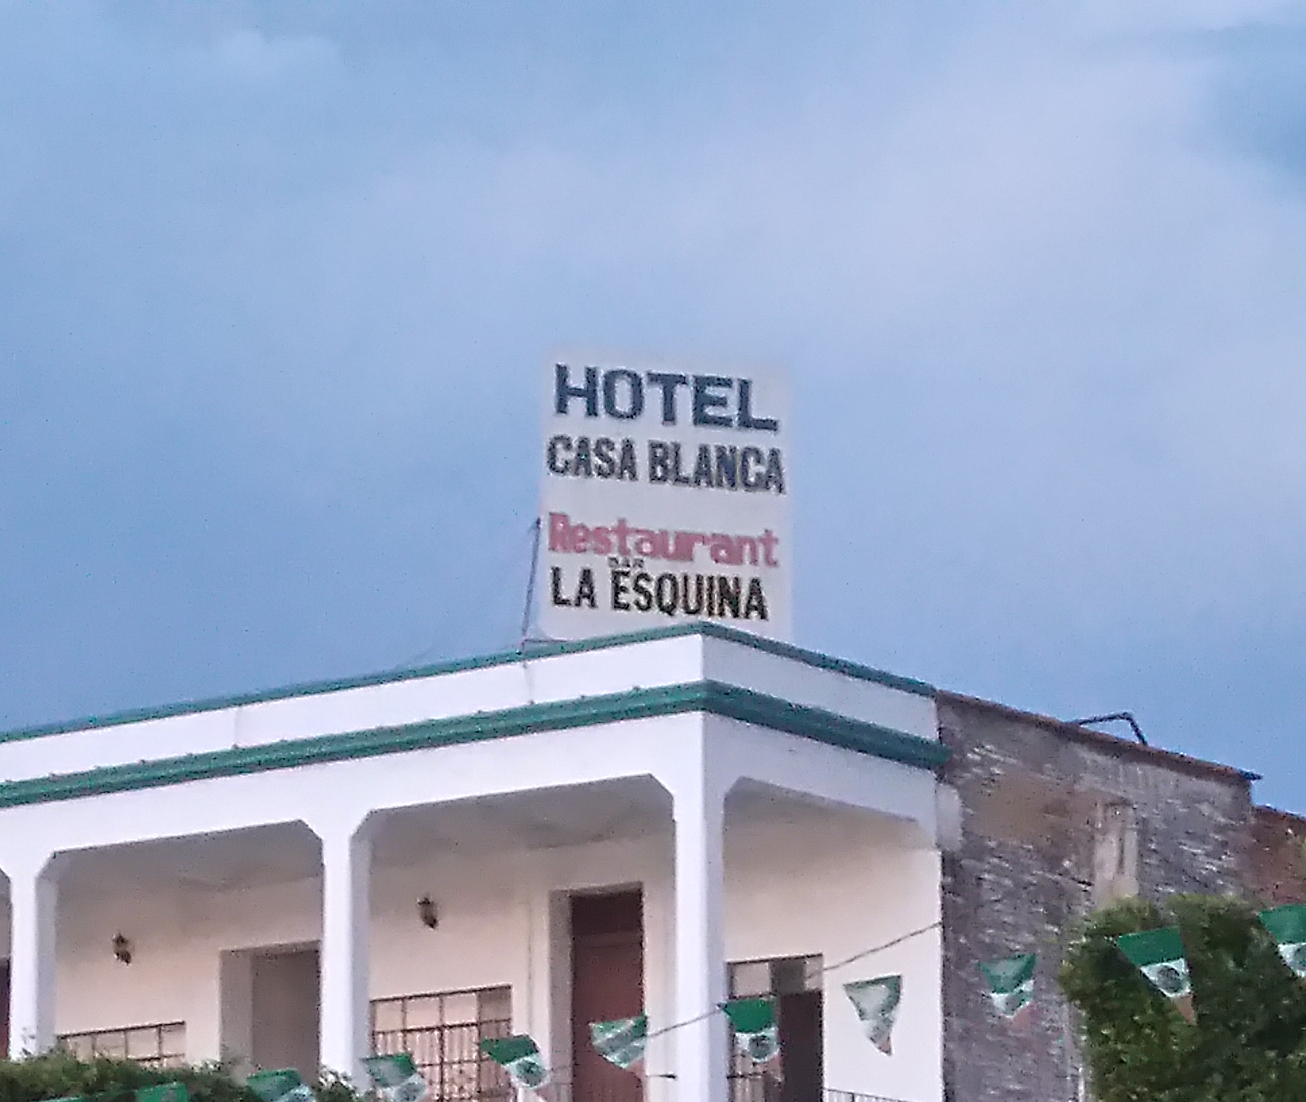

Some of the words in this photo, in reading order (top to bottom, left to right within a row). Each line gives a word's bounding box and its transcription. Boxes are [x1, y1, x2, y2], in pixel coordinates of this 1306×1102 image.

[554, 363, 780, 431] HOTEL
[546, 434, 639, 482] CASA
[647, 439, 787, 495] BLANCA
[548, 511, 779, 567] Restaurant
[550, 566, 598, 609] LA
[610, 568, 769, 621] ESQUINA
